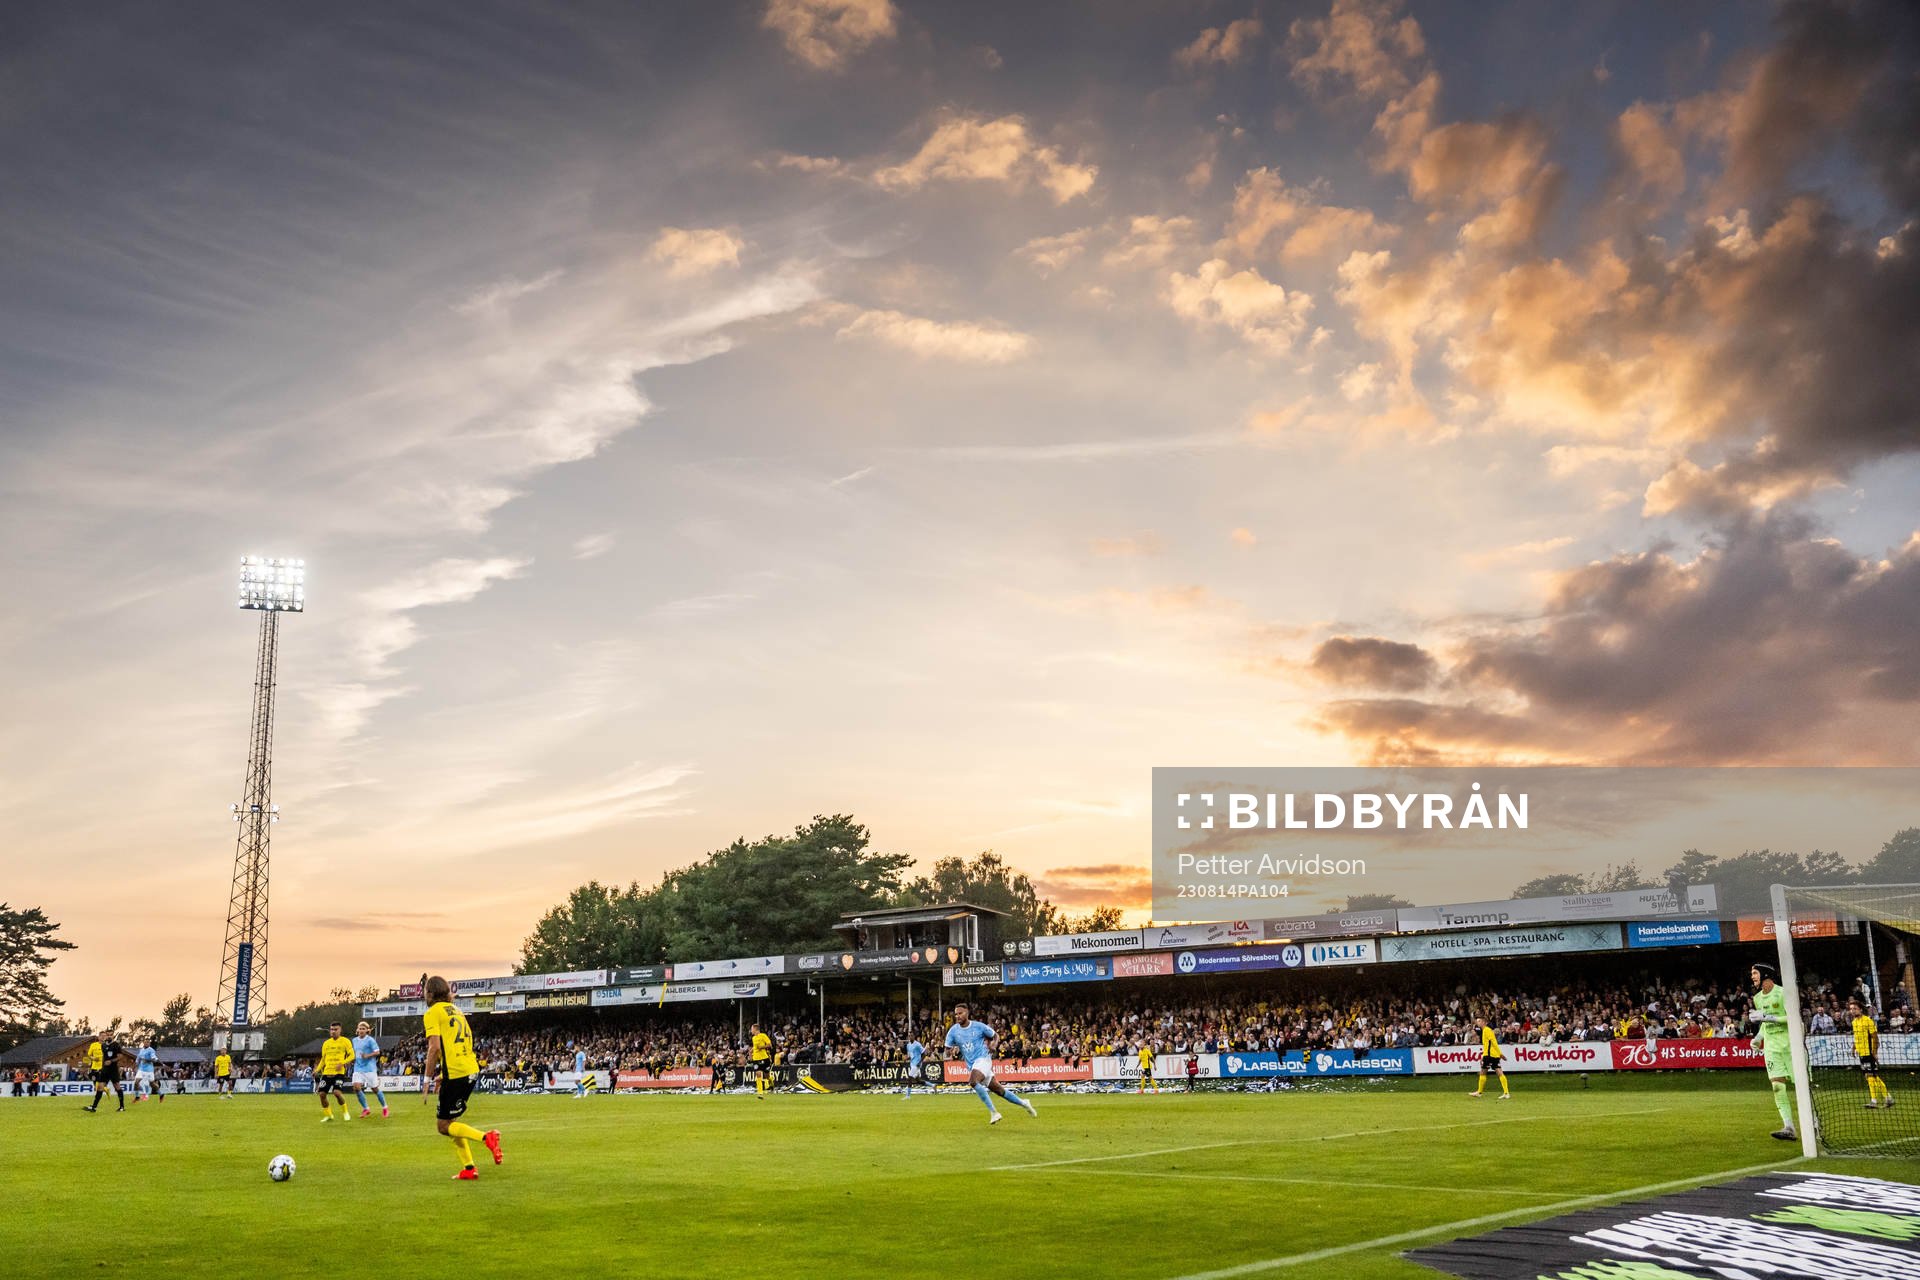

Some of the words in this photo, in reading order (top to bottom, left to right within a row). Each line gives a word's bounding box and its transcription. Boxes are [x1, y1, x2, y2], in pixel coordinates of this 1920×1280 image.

[1640, 894, 1676, 902] HULTMA
[1340, 915, 1383, 927] colorama
[1442, 912, 1509, 925] Tammp
[1233, 921, 1249, 930] ICA
[1275, 920, 1315, 931] colorama
[1638, 924, 1709, 935] Handelsbanken
[1071, 935, 1138, 949] Mekonomen
[1431, 939, 1466, 949] HOTELL
[1473, 937, 1490, 946] SPA
[1498, 933, 1565, 945] RESTAURANG
[241, 947, 251, 983] GRUPPEN
[1198, 956, 1240, 965] Moderaterna
[1241, 954, 1279, 963] Sölvesborg
[965, 965, 999, 975] NILSSONS
[1021, 967, 1039, 977] Mias
[1064, 964, 1070, 975] &
[1126, 964, 1160, 974] CHARK
[457, 981, 484, 989] BRANDAB
[666, 986, 696, 994] AHLBERG
[601, 989, 622, 998] STENA
[1427, 1048, 1483, 1064] Hemk
[1515, 1045, 1595, 1063] Hemköp
[1661, 1048, 1676, 1059] HS
[1679, 1047, 1716, 1058] Service
[1720, 1047, 1728, 1057] &
[1732, 1046, 1764, 1059] Suppo
[1334, 1059, 1402, 1069] LARSSON
